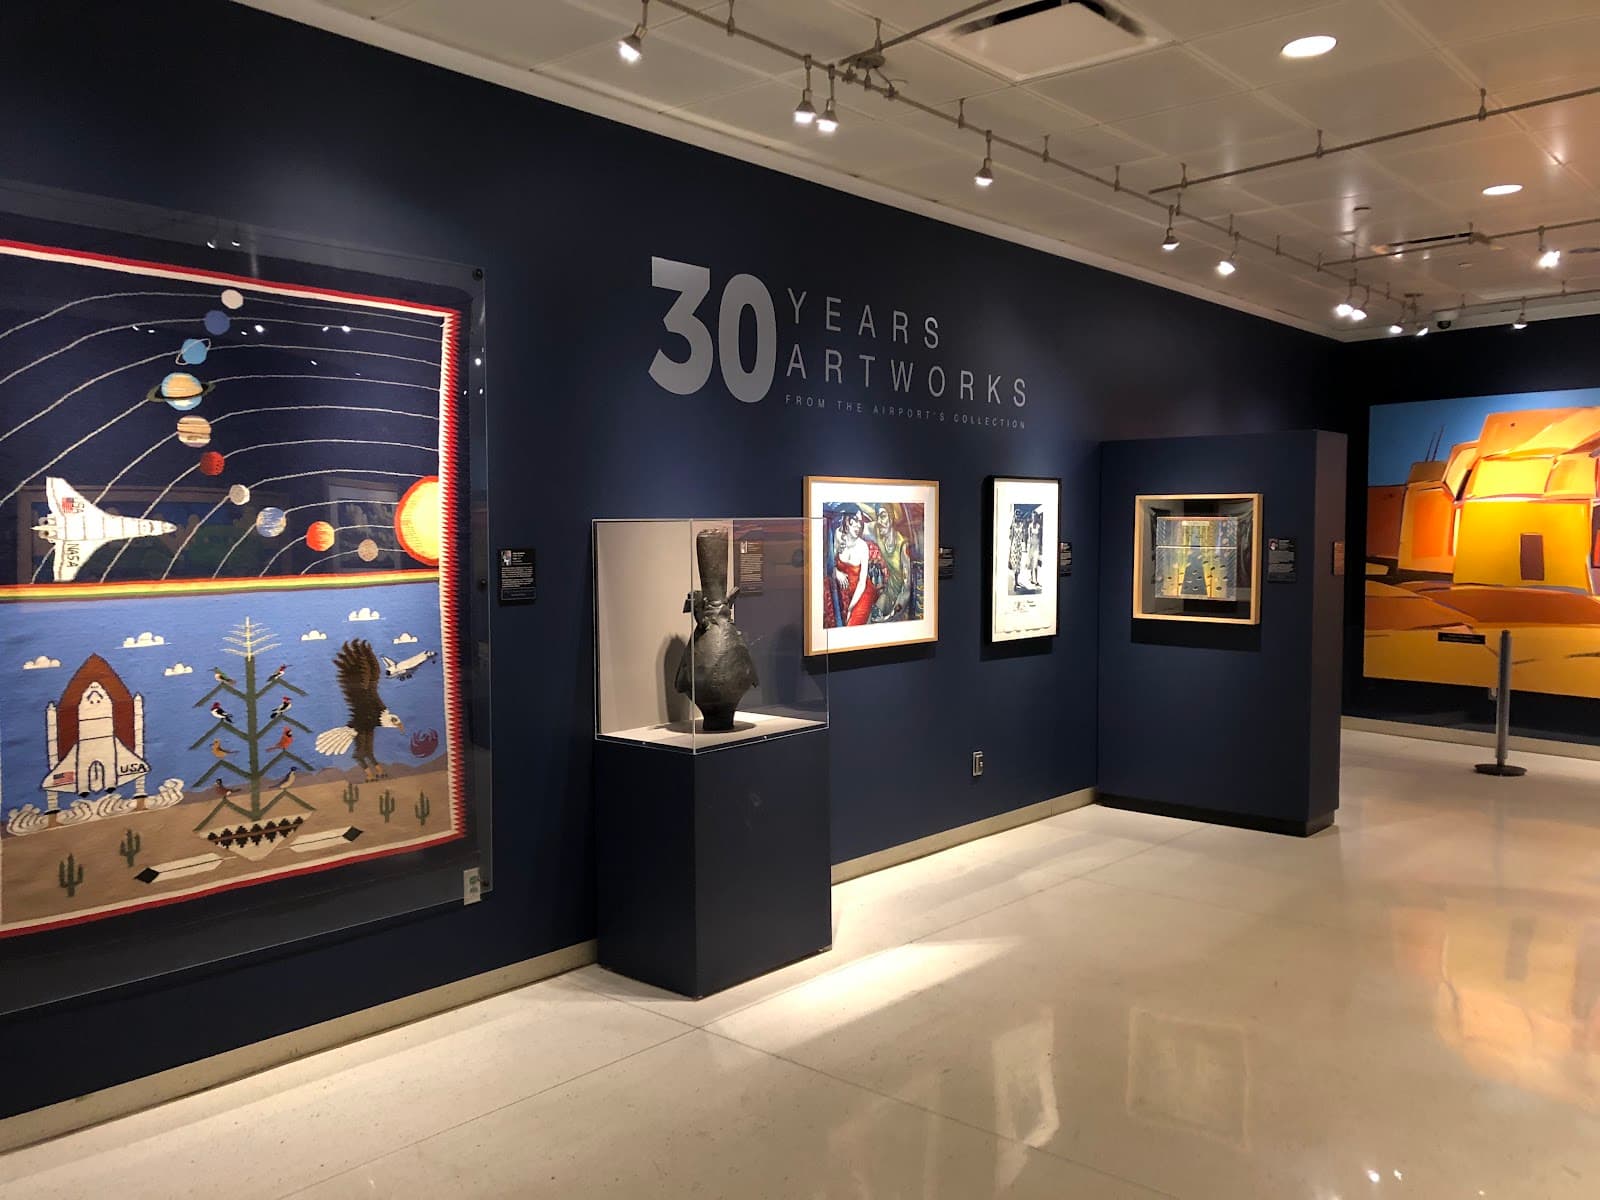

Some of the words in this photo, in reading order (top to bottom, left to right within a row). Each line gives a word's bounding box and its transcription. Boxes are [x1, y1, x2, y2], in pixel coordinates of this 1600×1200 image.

[649, 256, 776, 403] 30
[788, 287, 939, 349] YEARS
[786, 344, 1026, 407] ARTWORKS
[785, 394, 825, 408] FROM
[837, 400, 863, 413] THE
[873, 404, 945, 421] AIRPORT'S
[953, 414, 1025, 429] COLLECTION
[66, 543, 80, 568] NASA
[120, 763, 147, 774] USA
